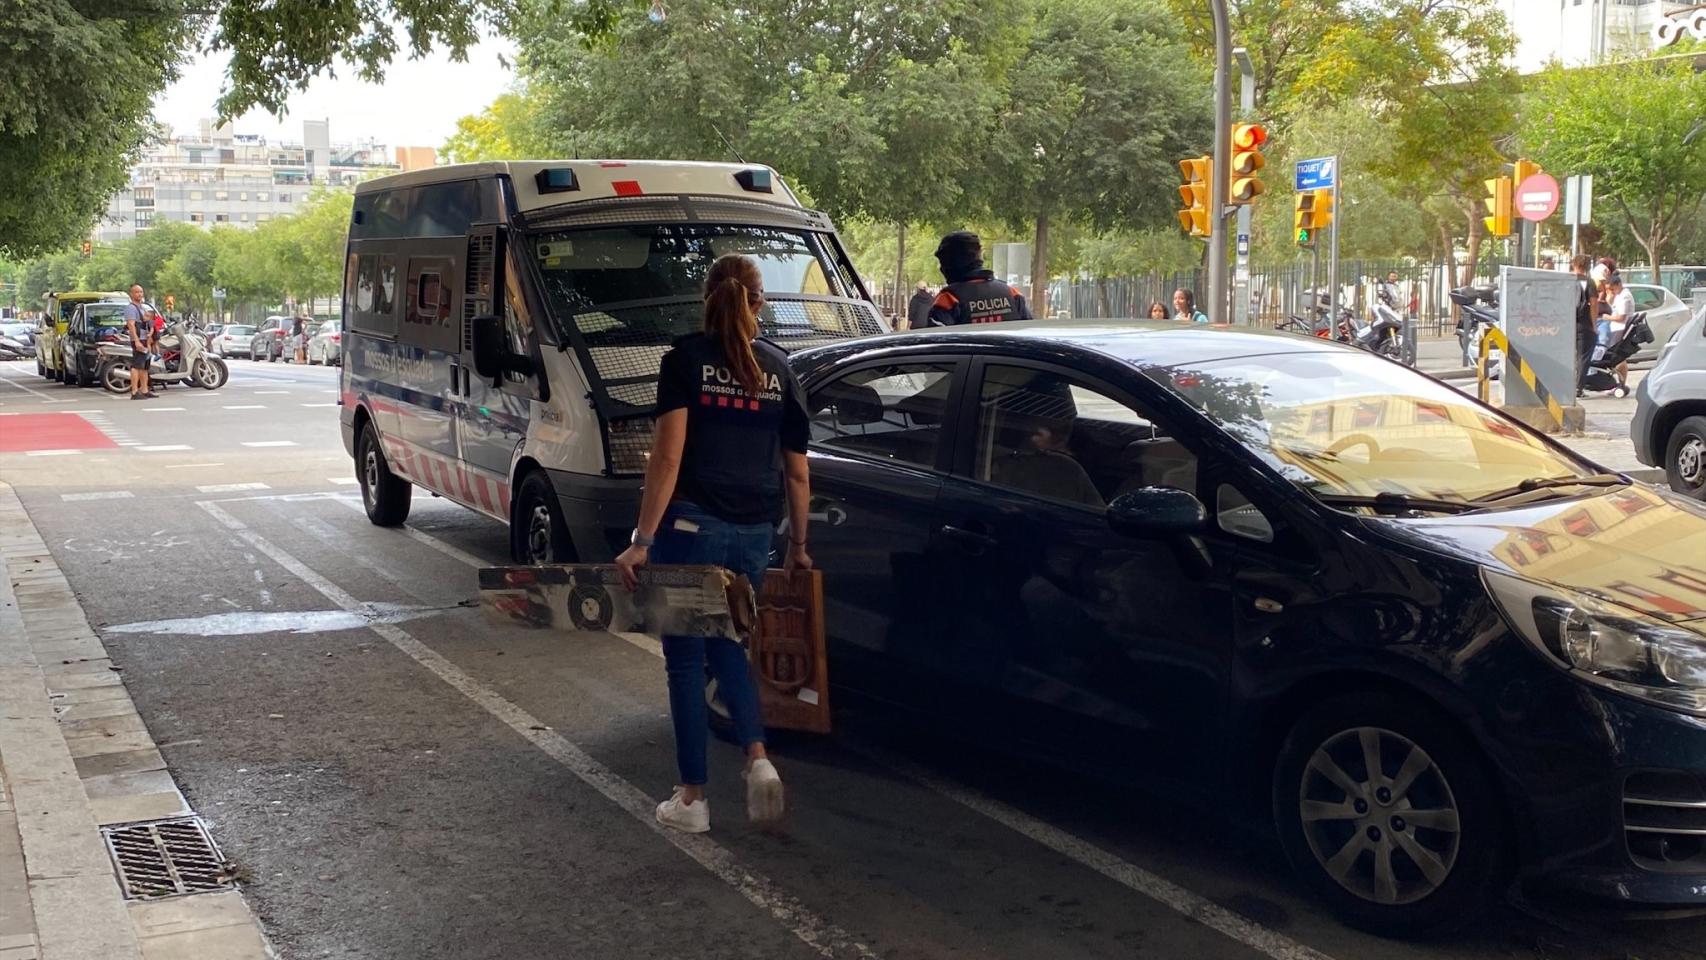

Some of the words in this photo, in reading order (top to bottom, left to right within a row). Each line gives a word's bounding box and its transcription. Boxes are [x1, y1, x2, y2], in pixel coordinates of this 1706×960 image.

[1297, 163, 1320, 174] TIQUET
[968, 297, 1011, 312] POLICIA
[702, 364, 782, 391] POIA
[702, 384, 735, 395] mossos
